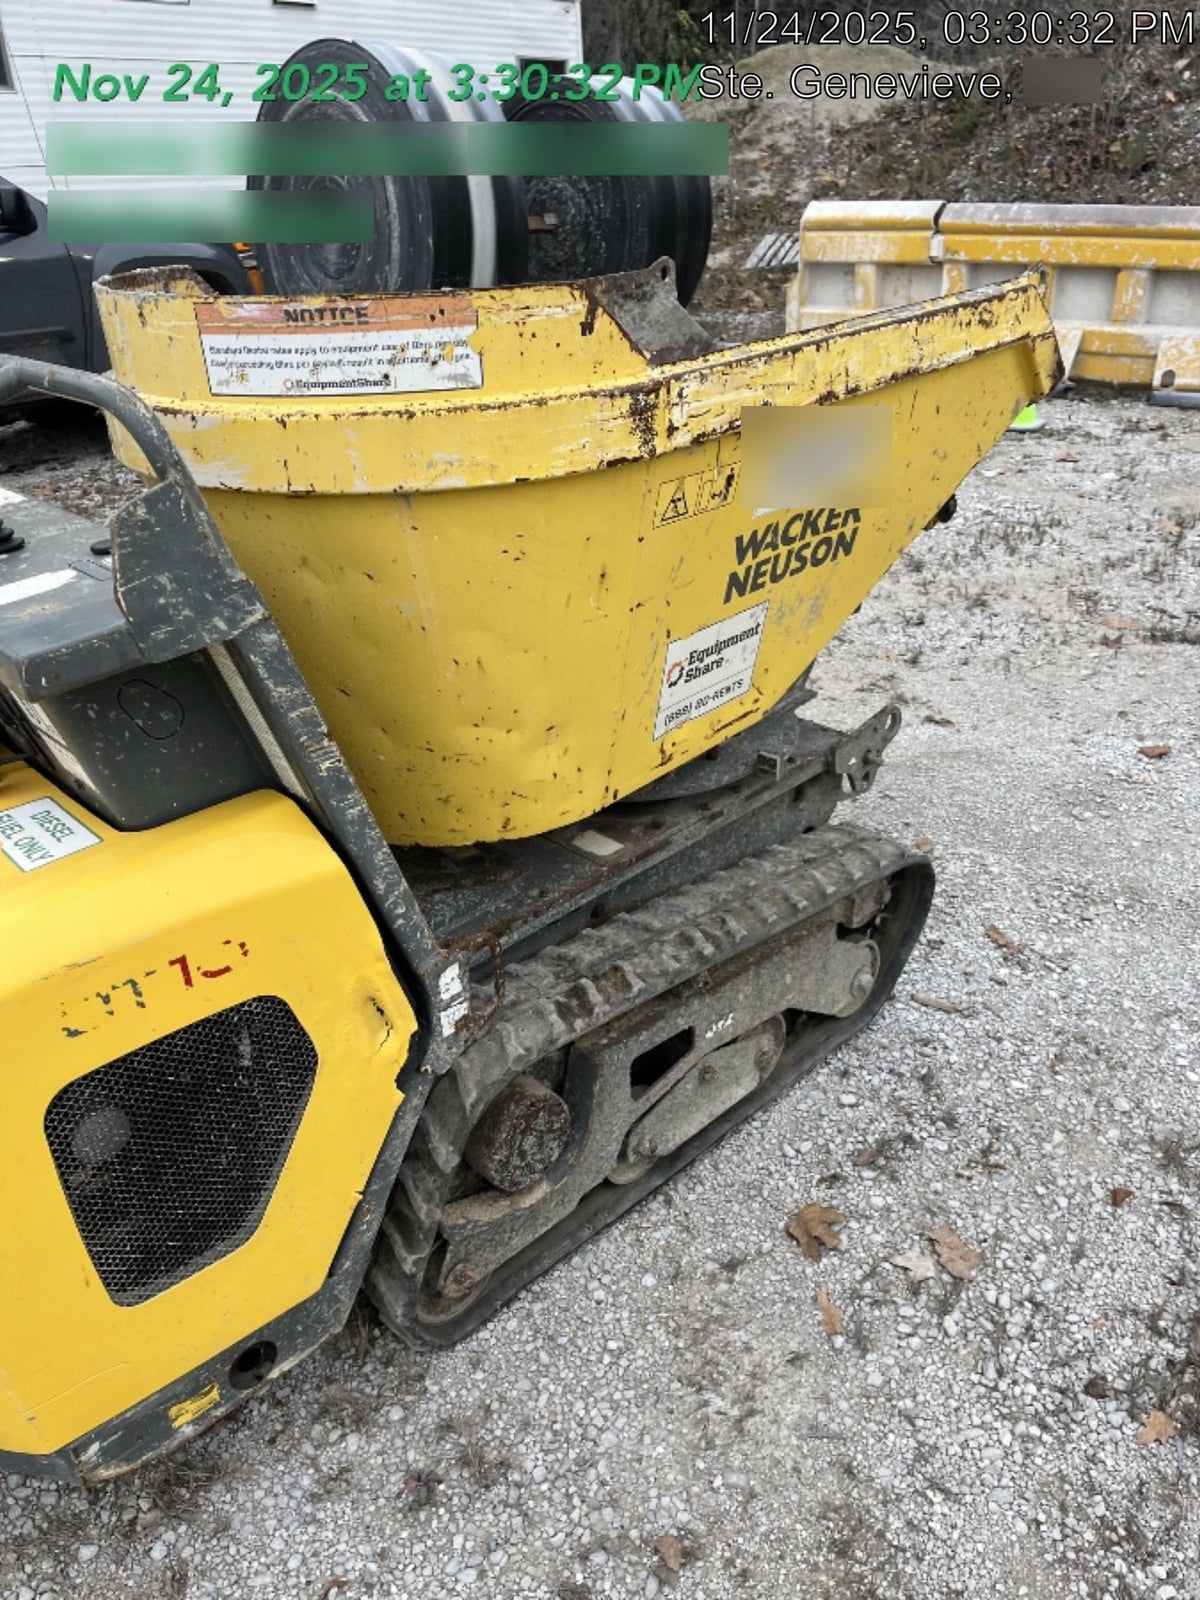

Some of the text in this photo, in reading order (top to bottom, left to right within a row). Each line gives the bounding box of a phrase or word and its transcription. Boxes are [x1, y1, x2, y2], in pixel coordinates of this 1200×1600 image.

[284, 306, 369, 327] NOTICE
[294, 346, 317, 356] apply
[319, 345, 329, 353] to
[735, 508, 861, 566] WACKER
[723, 526, 859, 605] NEUSON
[687, 622, 761, 666] Equipment
[684, 657, 724, 683] Share
[30, 810, 75, 843] DIESEL
[14, 836, 55, 863] ONLY
